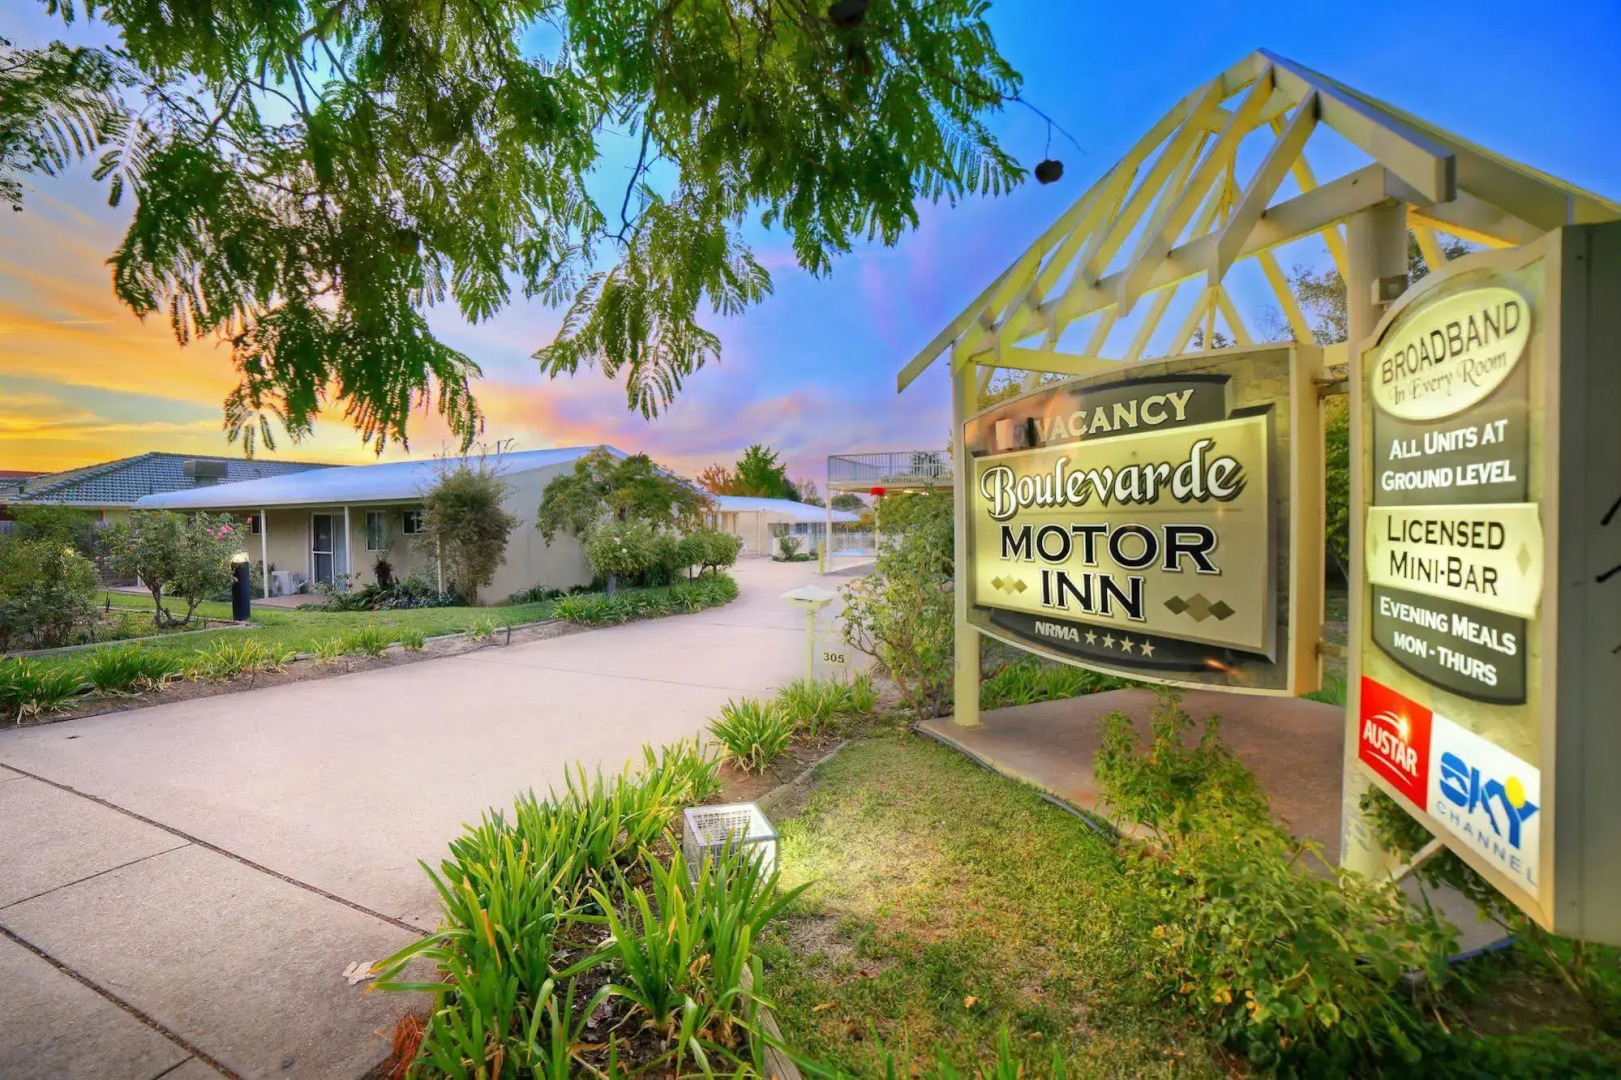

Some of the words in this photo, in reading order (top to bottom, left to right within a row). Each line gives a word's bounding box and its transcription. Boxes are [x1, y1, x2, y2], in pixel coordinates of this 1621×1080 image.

[1382, 300, 1519, 384] BROADBAND
[1390, 385, 1405, 405] In
[1408, 372, 1453, 400] Every
[1457, 352, 1507, 388] Room
[1035, 388, 1194, 442] VACANCY
[1389, 439, 1421, 460] ALL
[1424, 426, 1478, 455] UNITS
[1481, 419, 1508, 446] AT
[980, 437, 1247, 521] Boulevarde
[1381, 468, 1454, 491] GROUND
[1456, 460, 1516, 486] LEVEL
[1000, 523, 1222, 575] MOTOR
[1387, 515, 1505, 550] LICENSED
[1040, 569, 1146, 623] INN
[1390, 550, 1498, 596] MINI-BAR
[1035, 620, 1079, 643] NRMA
[1380, 596, 1449, 633] EVENING
[1451, 613, 1517, 656] MEALS
[823, 652, 845, 664] 305
[1436, 646, 1498, 687] THURS
[1363, 719, 1419, 777] AUSTAR
[1440, 751, 1541, 850] SKY
[1437, 800, 1538, 887] CHANNEL
